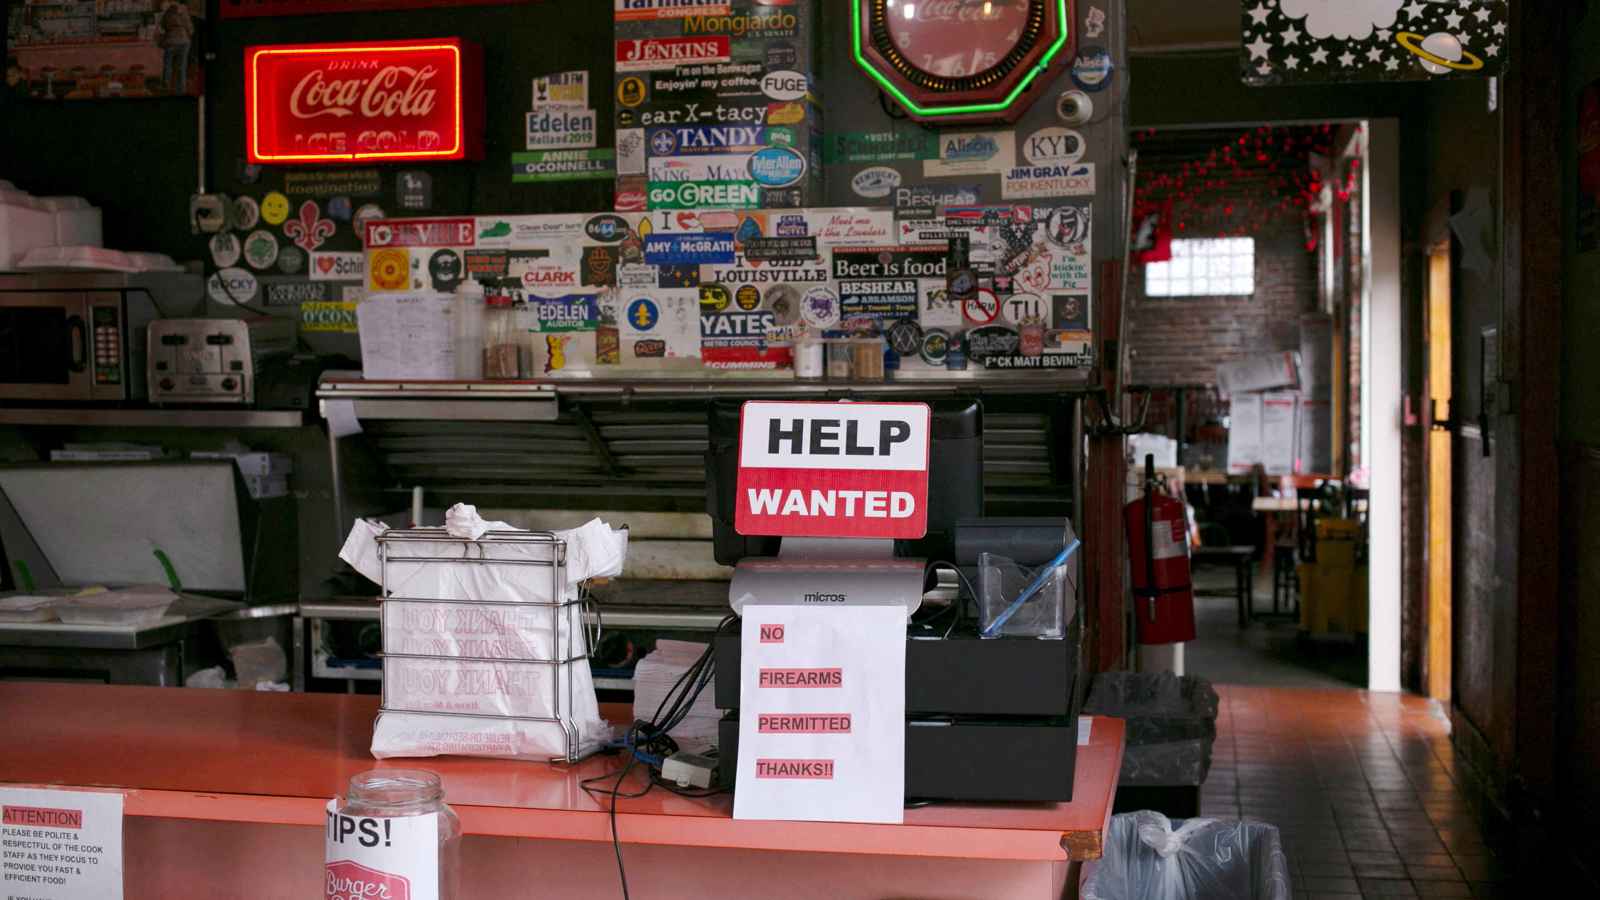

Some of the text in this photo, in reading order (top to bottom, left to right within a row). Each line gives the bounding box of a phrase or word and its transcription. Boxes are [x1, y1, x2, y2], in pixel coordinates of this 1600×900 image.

[684, 10, 796, 36] Mongiardo
[626, 40, 719, 60] JENKINS
[328, 60, 379, 71] DRINK
[290, 65, 439, 119] Coca-Cola
[656, 79, 698, 91] Enjoyin'
[701, 80, 718, 90] my
[764, 78, 806, 92] FUGE
[529, 112, 593, 133] Edelen
[641, 109, 681, 125] ear
[677, 126, 763, 147] TANDY
[945, 138, 994, 153] Alison
[1031, 136, 1079, 158] KYD
[542, 151, 589, 161] ANNIE
[651, 167, 689, 181] KING
[1006, 166, 1070, 180] JIM GRAY
[1007, 177, 1091, 190] FOR KENTUCKY
[650, 191, 675, 203] GO
[677, 183, 758, 206] GREEN
[896, 188, 976, 207] BESHEAR
[661, 212, 671, 230] I
[646, 242, 671, 254] AMY
[680, 241, 735, 253] McGRATH
[836, 257, 947, 276] Beer is food
[523, 270, 576, 283] CLARK
[714, 269, 828, 283] LOUISVILLE
[212, 278, 254, 290] ROCKY
[841, 282, 916, 294] BESHEAR
[540, 303, 589, 321] EDELEN
[547, 320, 585, 329] AUDITOR
[701, 315, 775, 336] YATES
[1014, 356, 1041, 366] MATT
[767, 418, 912, 456] HELP
[748, 488, 915, 518] WANTED
[804, 591, 846, 602] micros
[760, 628, 785, 640] NO
[759, 671, 843, 686] FIREARMS
[758, 716, 851, 731] PERMITTED
[756, 762, 834, 777] THANKS!!
[2, 829, 31, 838] PLEASE
[32, 830, 43, 838] BE
[44, 831, 72, 840] POLITE
[327, 811, 392, 847] TIPS!
[2, 840, 103, 854] RESPECTFUL OF THE COOK
[3, 851, 25, 859] STAFF
[27, 852, 37, 860] AS
[39, 853, 58, 862] THEY
[60, 855, 86, 864] FOCUS
[3, 862, 81, 875] PROVIDE YOU FAST &
[4, 873, 67, 885] EFFICIENT FOOD!
[327, 870, 393, 900] Burger
